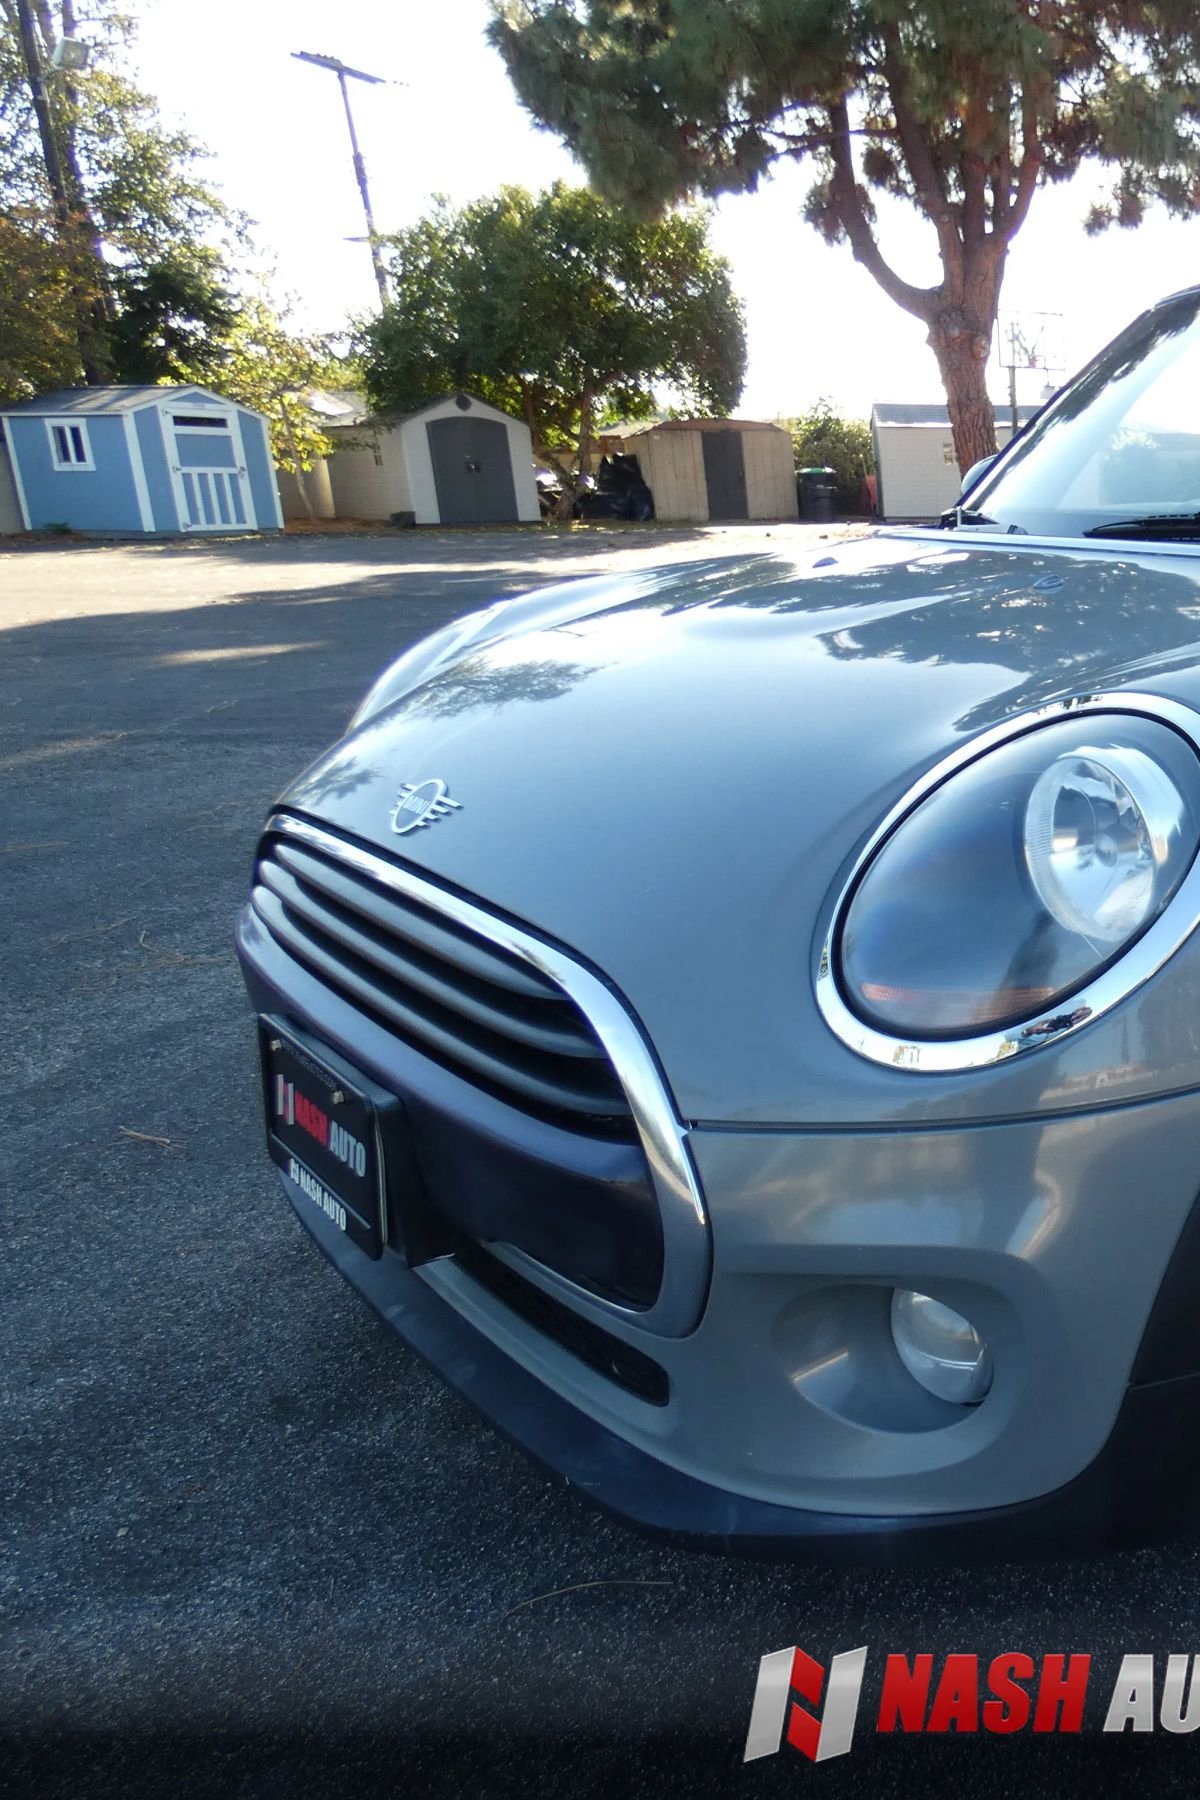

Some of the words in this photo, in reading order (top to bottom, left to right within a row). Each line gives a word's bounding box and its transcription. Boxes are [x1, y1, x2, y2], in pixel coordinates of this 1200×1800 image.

[294, 1089, 328, 1148] NASH
[329, 1120, 366, 1178] AUTO
[300, 1167, 323, 1207] NASH
[323, 1191, 347, 1232] AUTO
